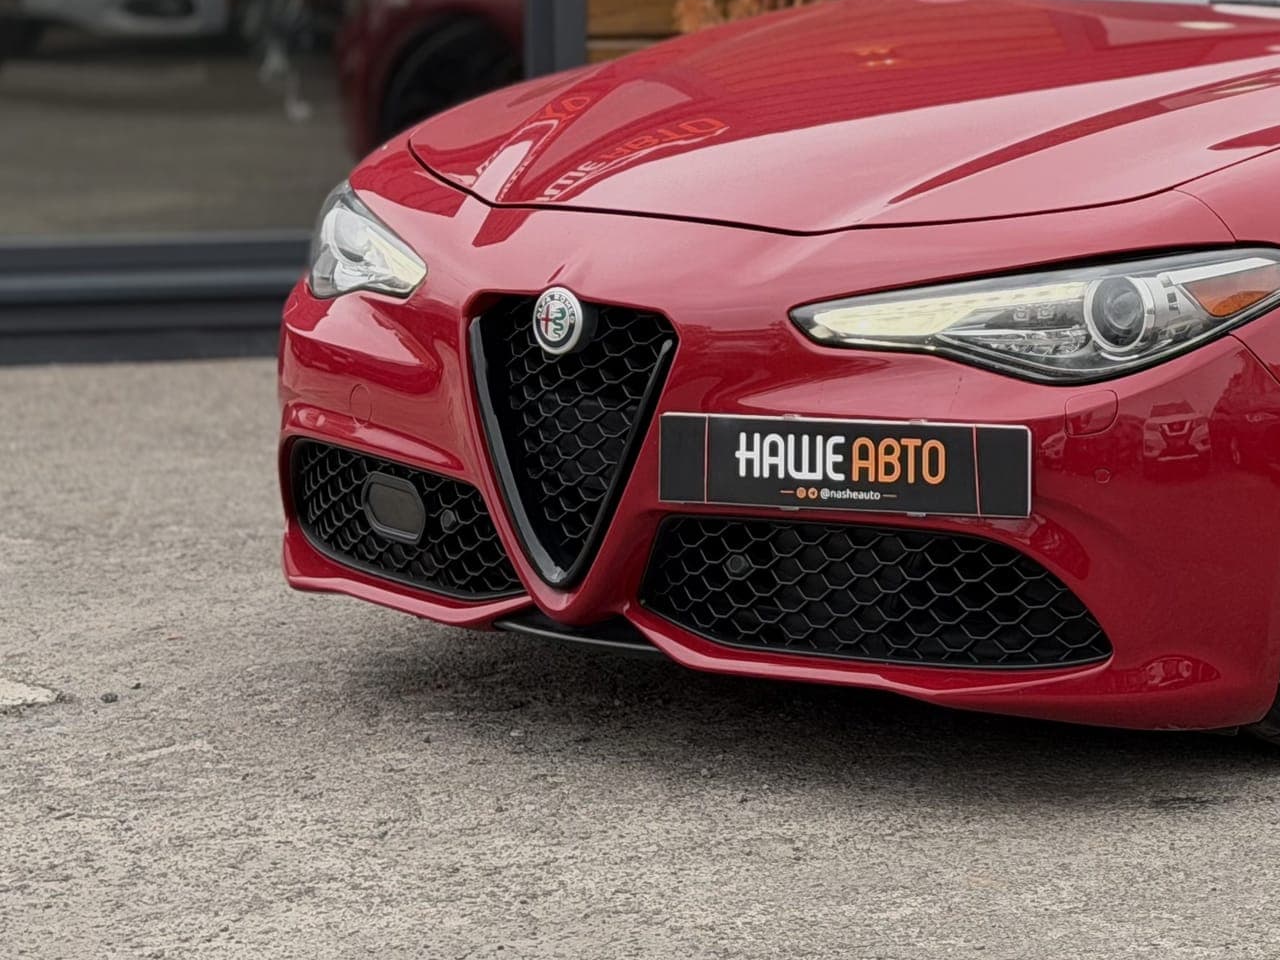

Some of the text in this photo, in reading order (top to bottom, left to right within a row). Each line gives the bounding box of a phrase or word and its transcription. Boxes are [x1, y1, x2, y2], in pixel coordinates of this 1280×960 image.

[554, 293, 576, 323] ROMEO
[734, 431, 947, 485] НАШЕ АВТО
[820, 486, 881, 500] @nasheauto
